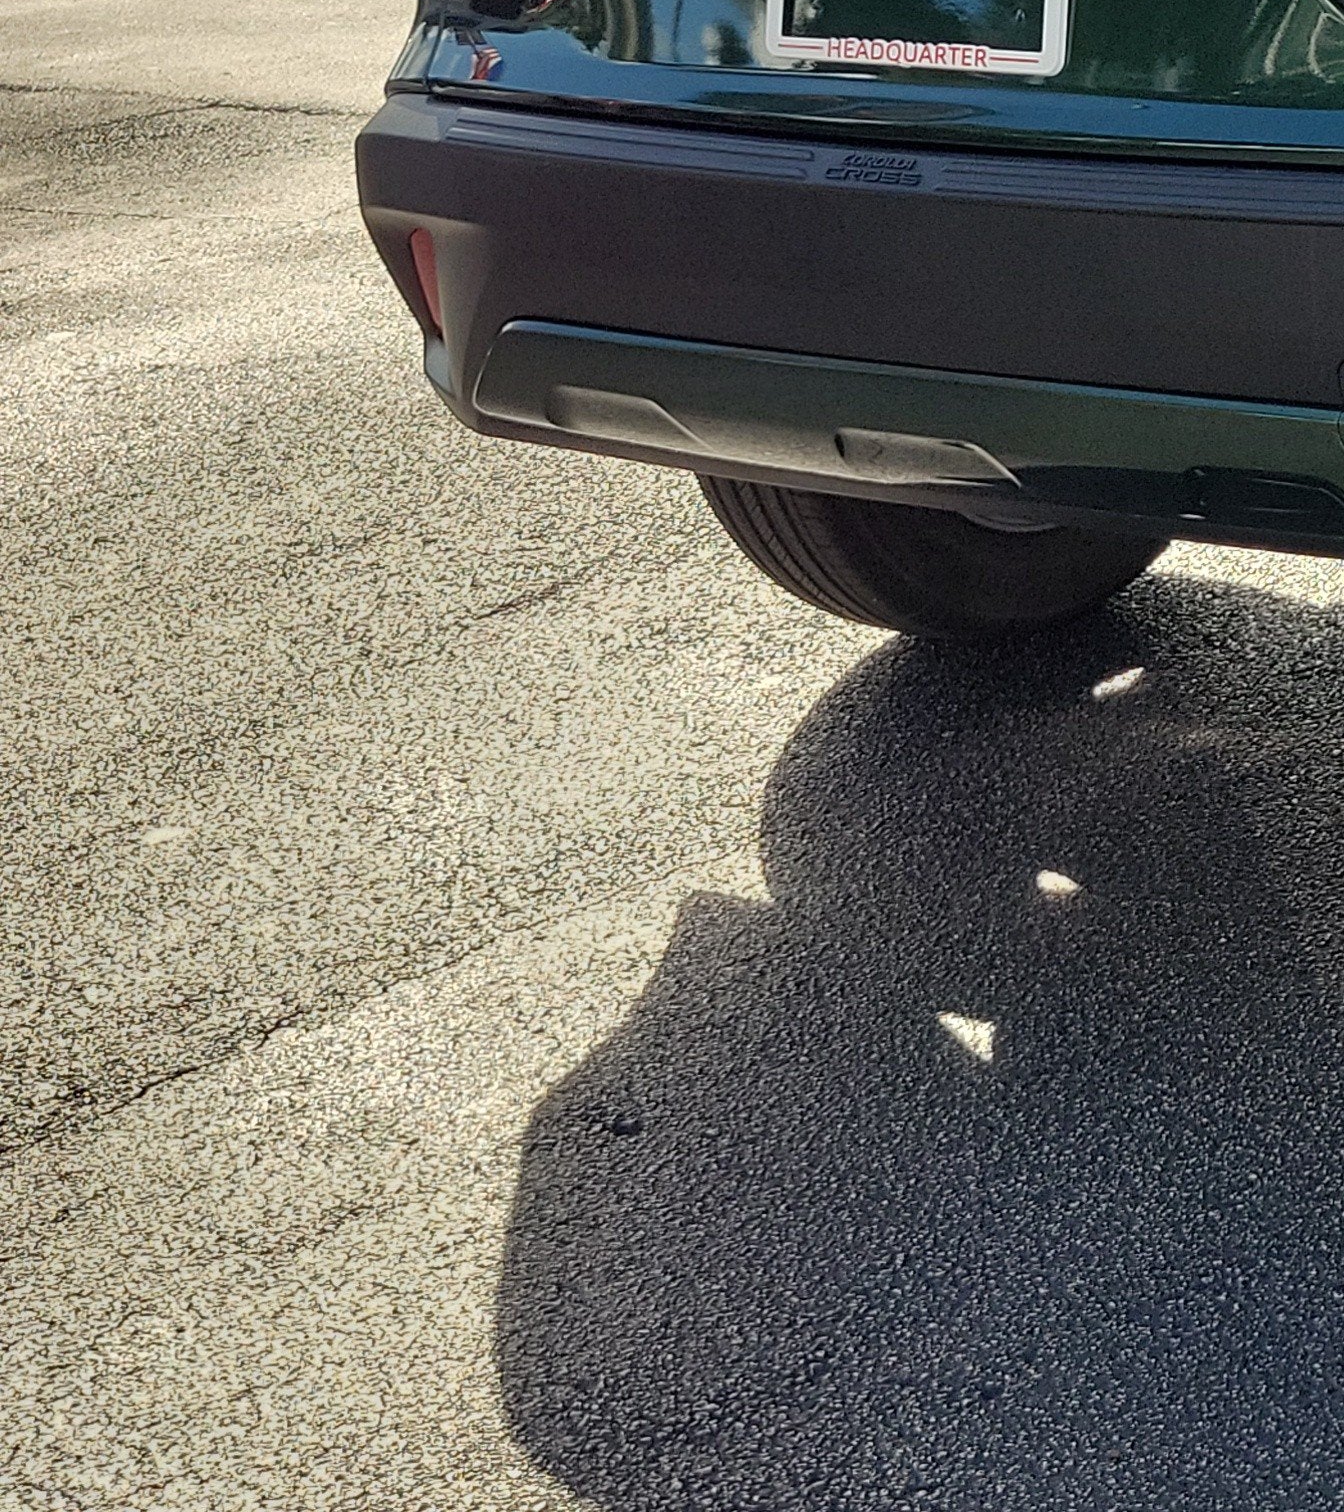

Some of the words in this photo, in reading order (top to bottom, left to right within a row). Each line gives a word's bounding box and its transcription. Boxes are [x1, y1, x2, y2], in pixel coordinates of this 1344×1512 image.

[827, 37, 990, 68] HEADQUARTER
[842, 153, 918, 171] COROLLA
[825, 167, 923, 186] CROSS
